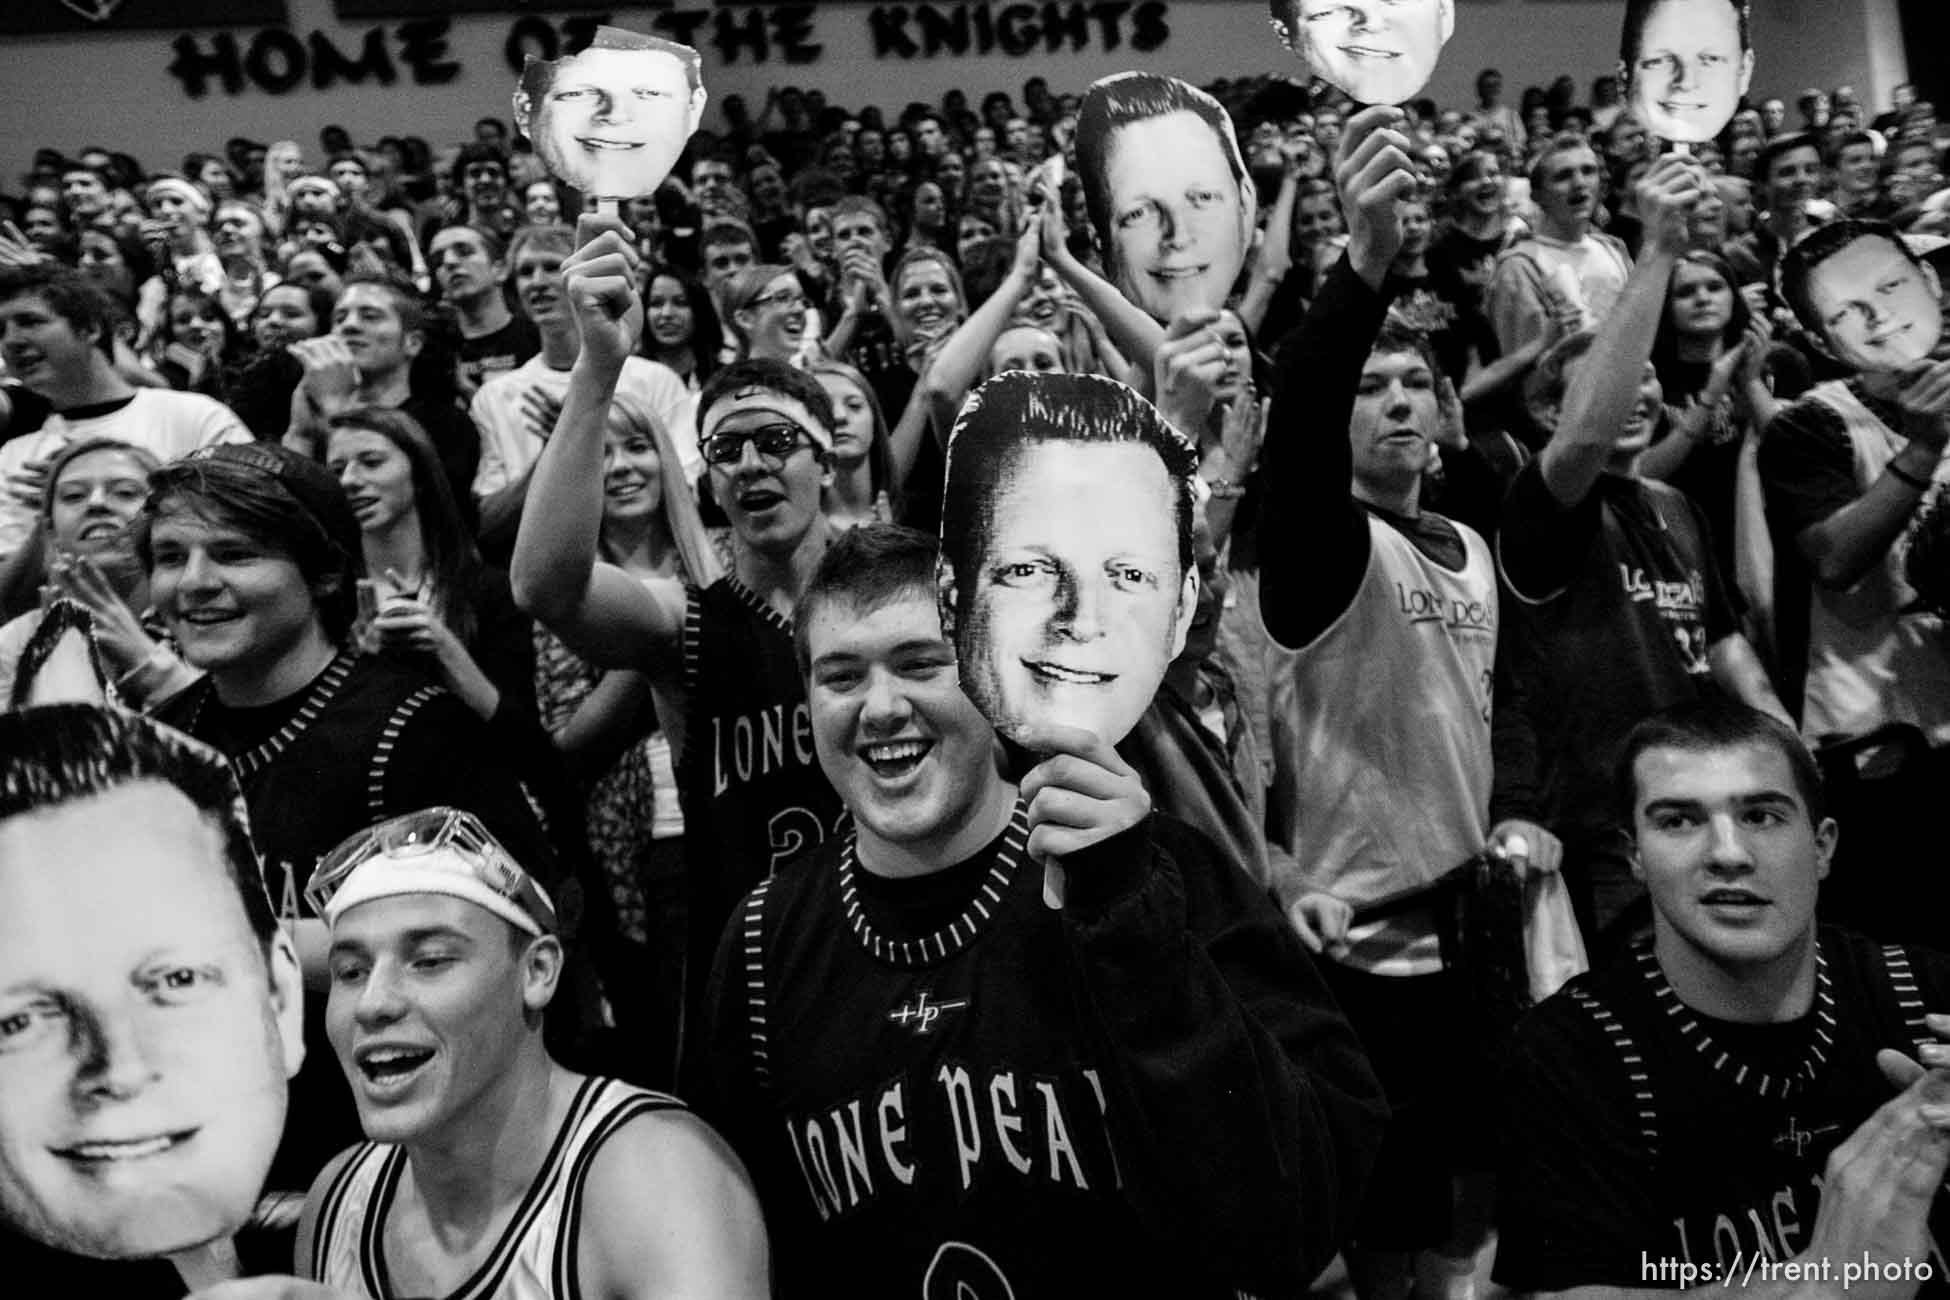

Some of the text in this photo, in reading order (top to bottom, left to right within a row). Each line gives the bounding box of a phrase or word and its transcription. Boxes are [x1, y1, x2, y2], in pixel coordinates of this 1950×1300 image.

[166, 20, 462, 100] HOME
[653, 3, 822, 66] THE
[868, 0, 1170, 58] KNIGHTS
[711, 702, 813, 798] LONE
[786, 1082, 916, 1222] LONE
